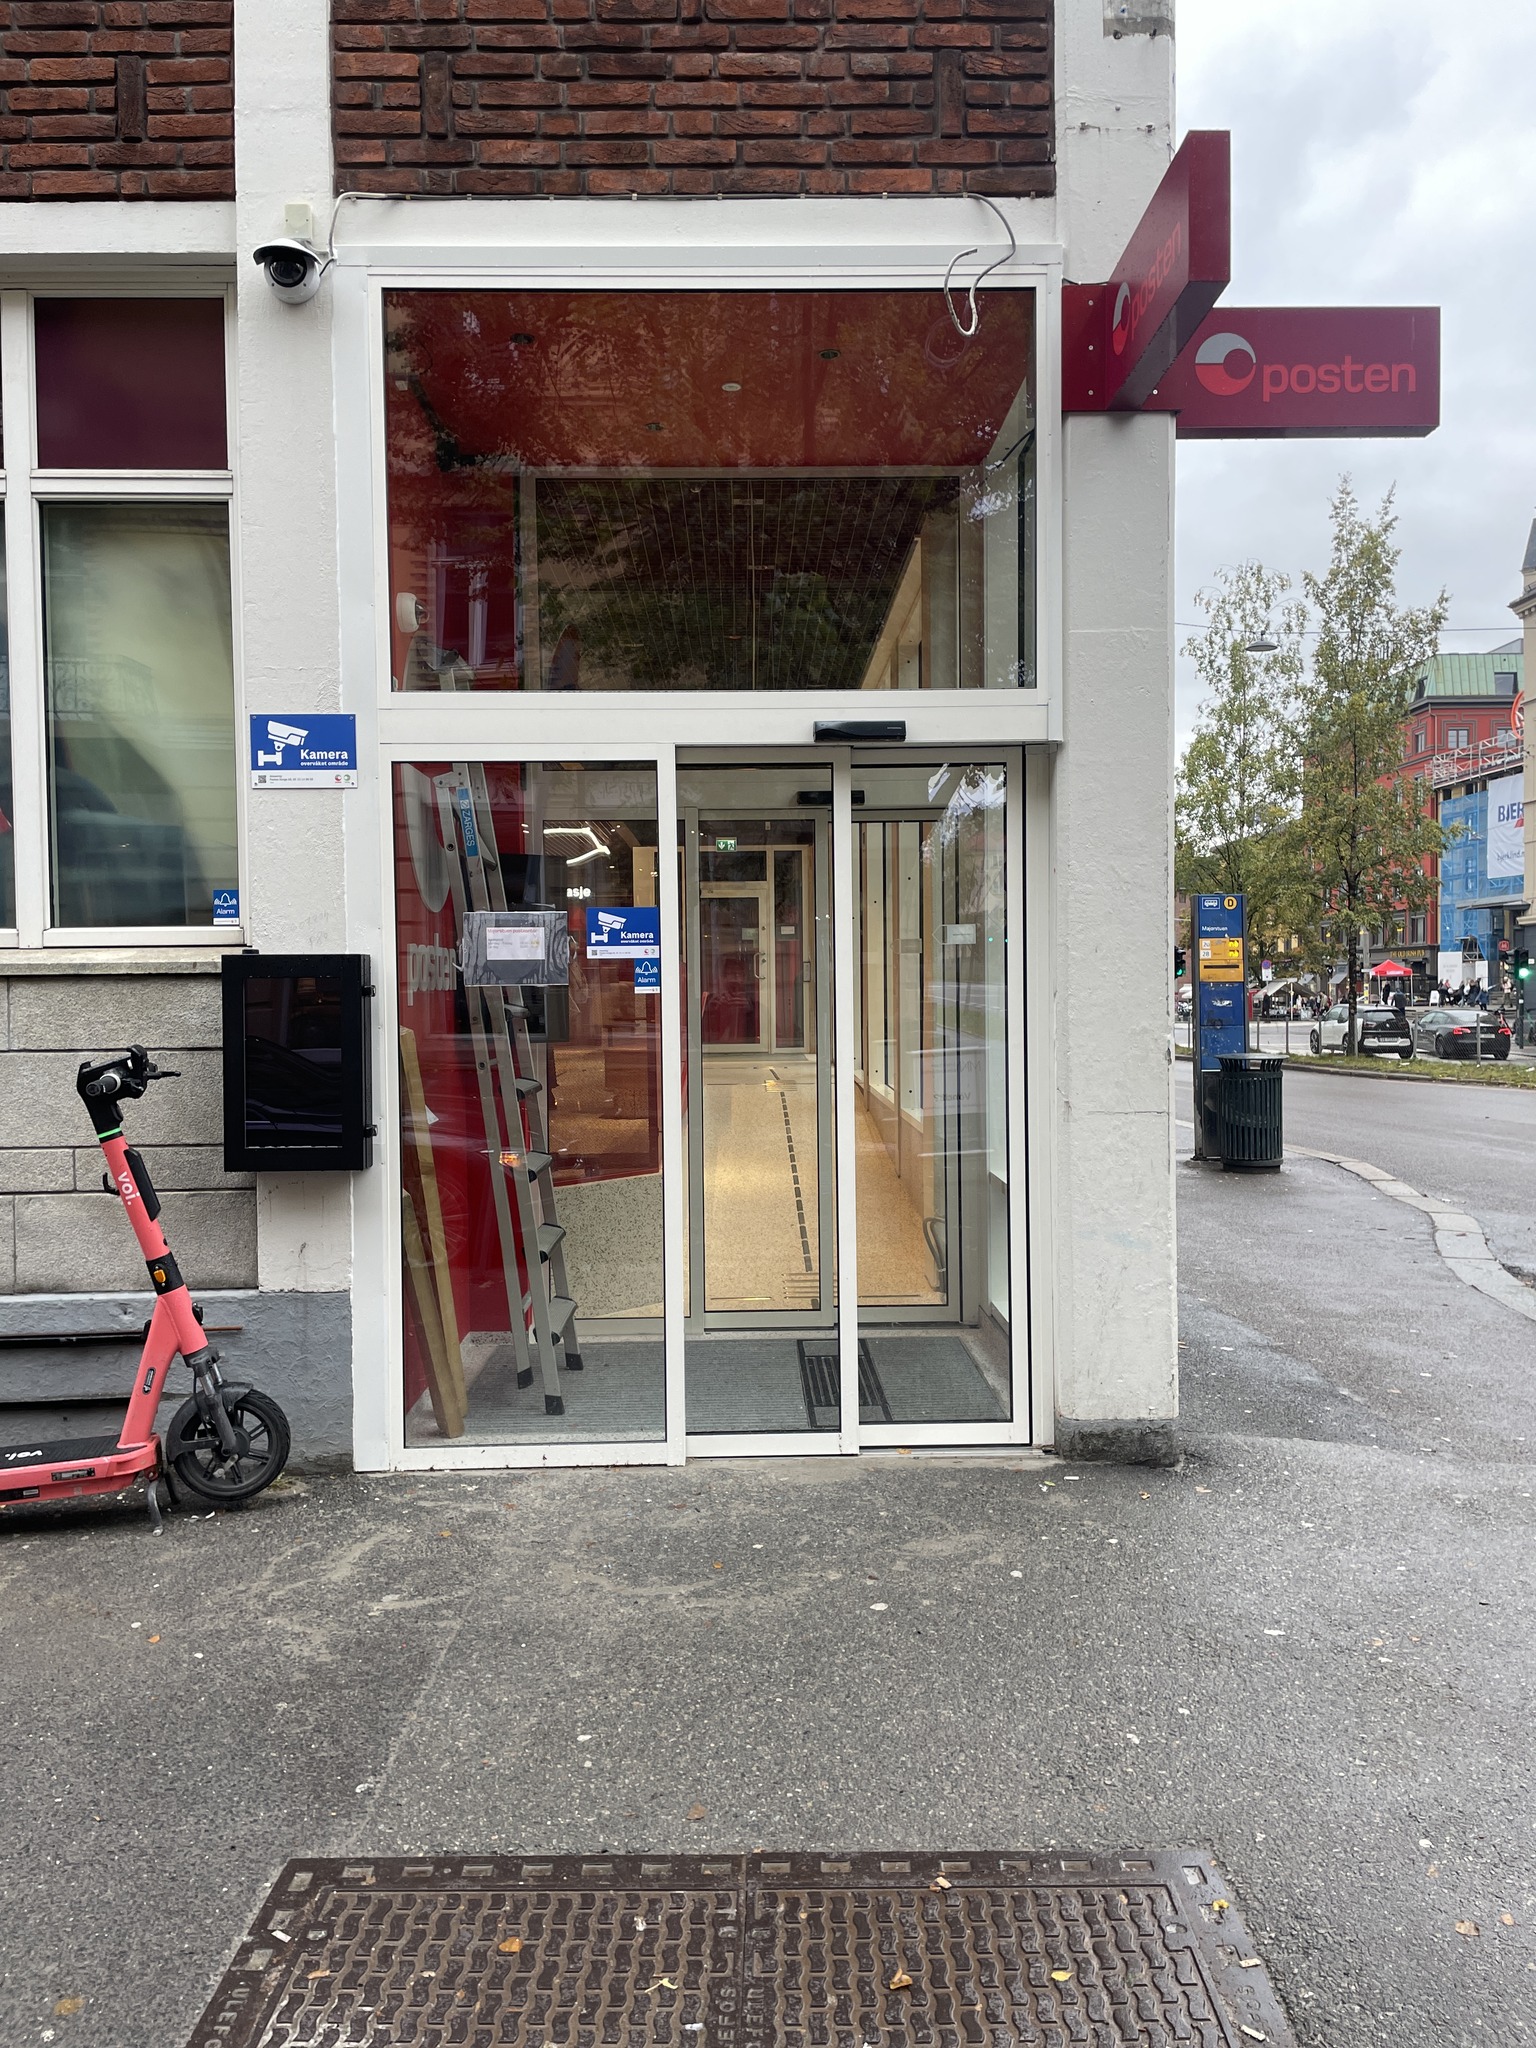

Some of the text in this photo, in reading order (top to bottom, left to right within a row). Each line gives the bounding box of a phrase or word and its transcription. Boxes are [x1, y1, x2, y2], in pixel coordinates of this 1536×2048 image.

[1130, 222, 1181, 339] posten
[1262, 355, 1417, 403] posten
[300, 749, 348, 760] Kamera
[462, 810, 476, 847] ZARGES
[1228, 899, 1234, 907] D
[620, 931, 654, 939] Kamera
[407, 933, 457, 1006] posten
[637, 976, 657, 984] Alarm
[118, 1171, 140, 1206] voi.
[5, 1450, 43, 1461] voi.
